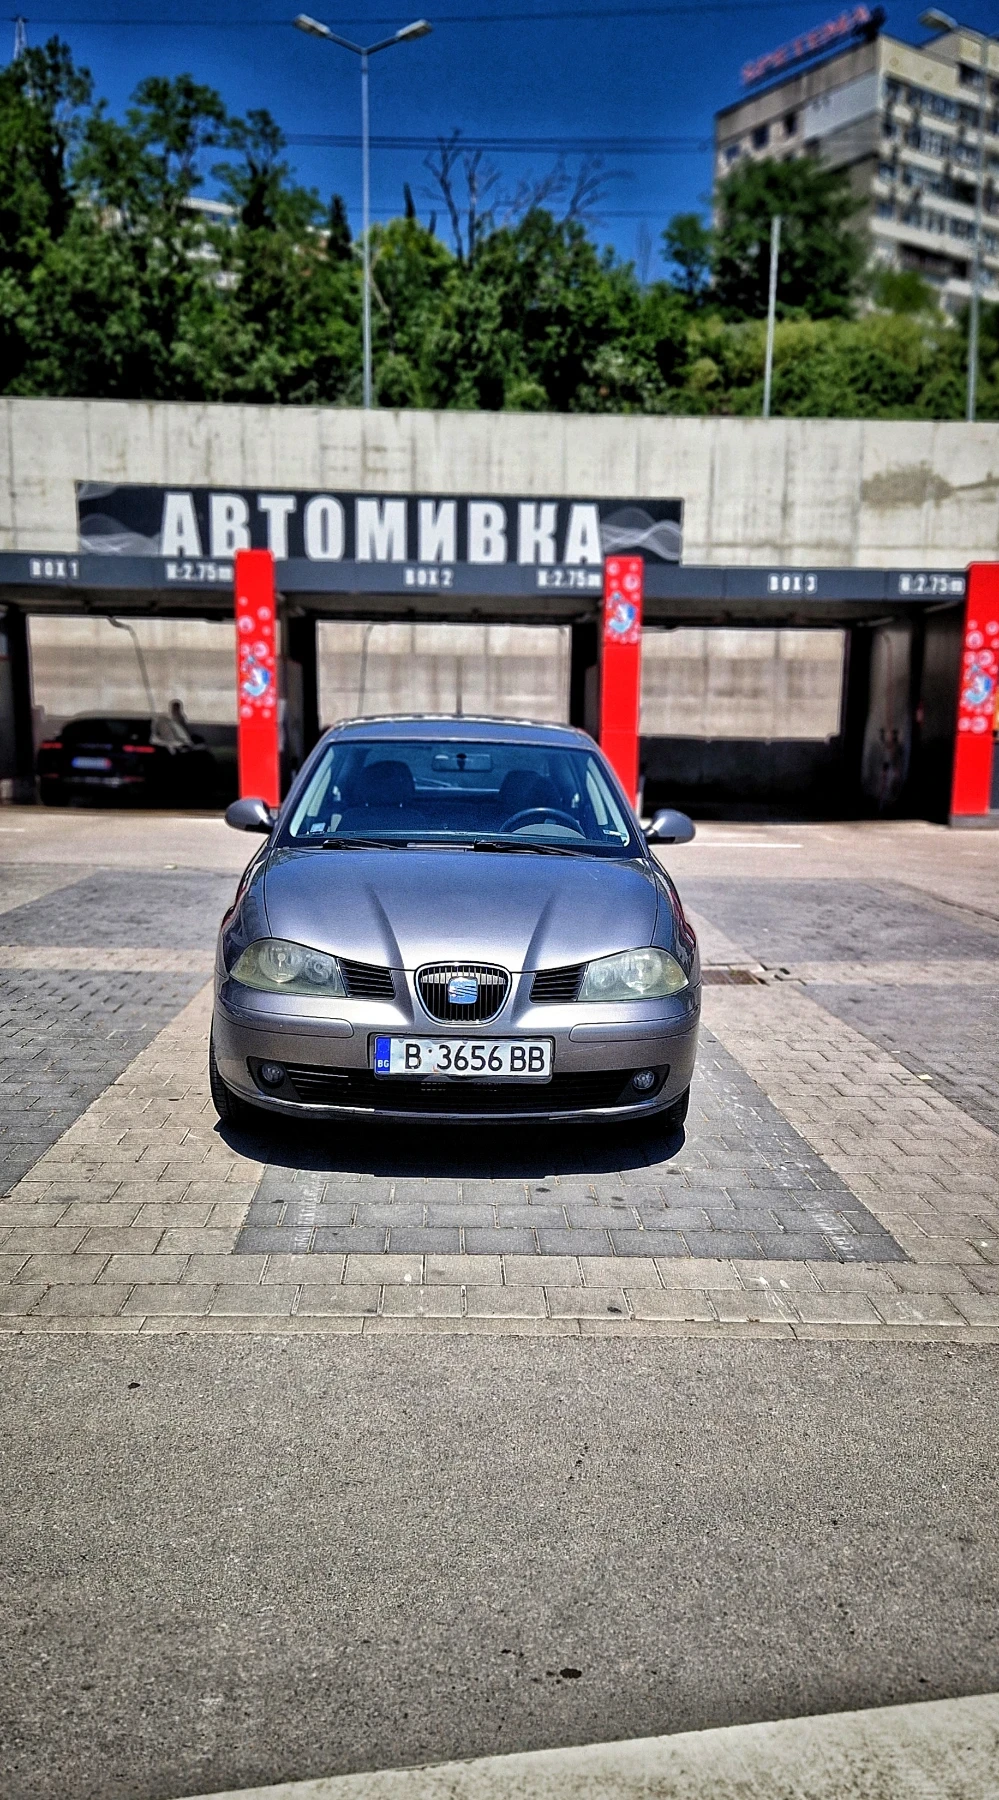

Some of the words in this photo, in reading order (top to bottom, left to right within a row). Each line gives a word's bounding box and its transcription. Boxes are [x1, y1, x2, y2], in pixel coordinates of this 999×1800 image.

[162, 493, 601, 564] АВТОМИВКА
[31, 560, 67, 578] BOX
[70, 561, 79, 578] 1
[404, 569, 439, 588] BOX
[442, 570, 452, 588] 2
[769, 575, 801, 593] BOX
[377, 1060, 390, 1070] BG
[436, 1044, 503, 1072] 3656
[510, 1046, 545, 1074] BB
